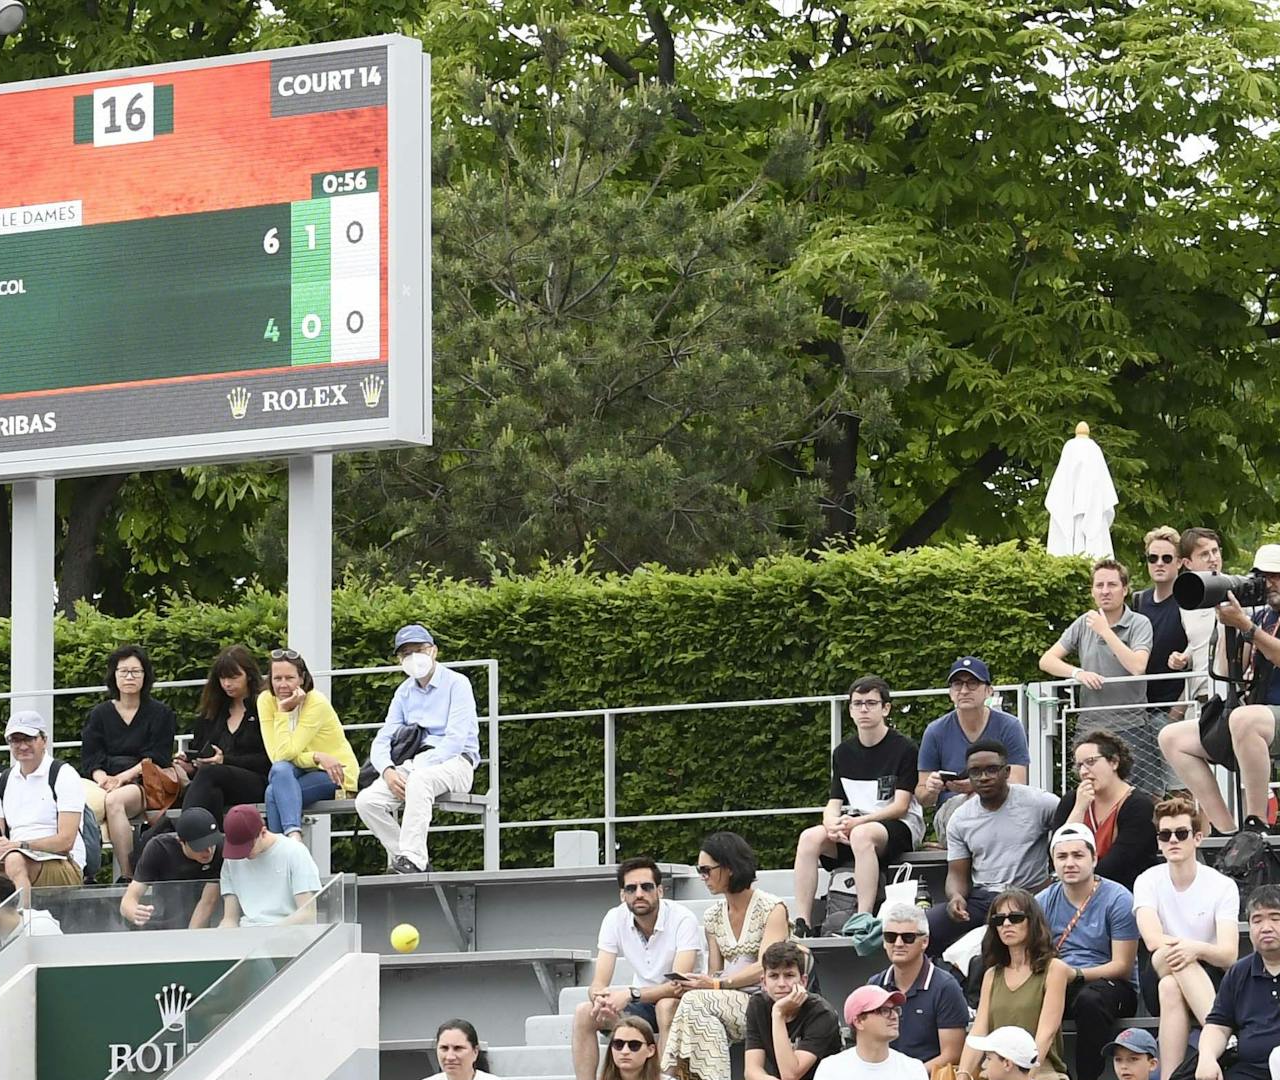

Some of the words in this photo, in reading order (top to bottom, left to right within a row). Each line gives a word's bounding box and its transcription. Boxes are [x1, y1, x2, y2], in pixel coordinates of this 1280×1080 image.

[278, 68, 355, 97] COURT
[358, 66, 382, 87] 14
[100, 92, 147, 135] 16
[322, 170, 368, 193] 0:56
[22, 205, 76, 225] DAMES
[263, 227, 280, 254] 6
[304, 224, 316, 250] 1
[346, 221, 363, 244] 0
[263, 318, 280, 342] 4
[301, 313, 322, 339] 0
[346, 310, 364, 334] 0
[262, 383, 348, 412] ROLEX
